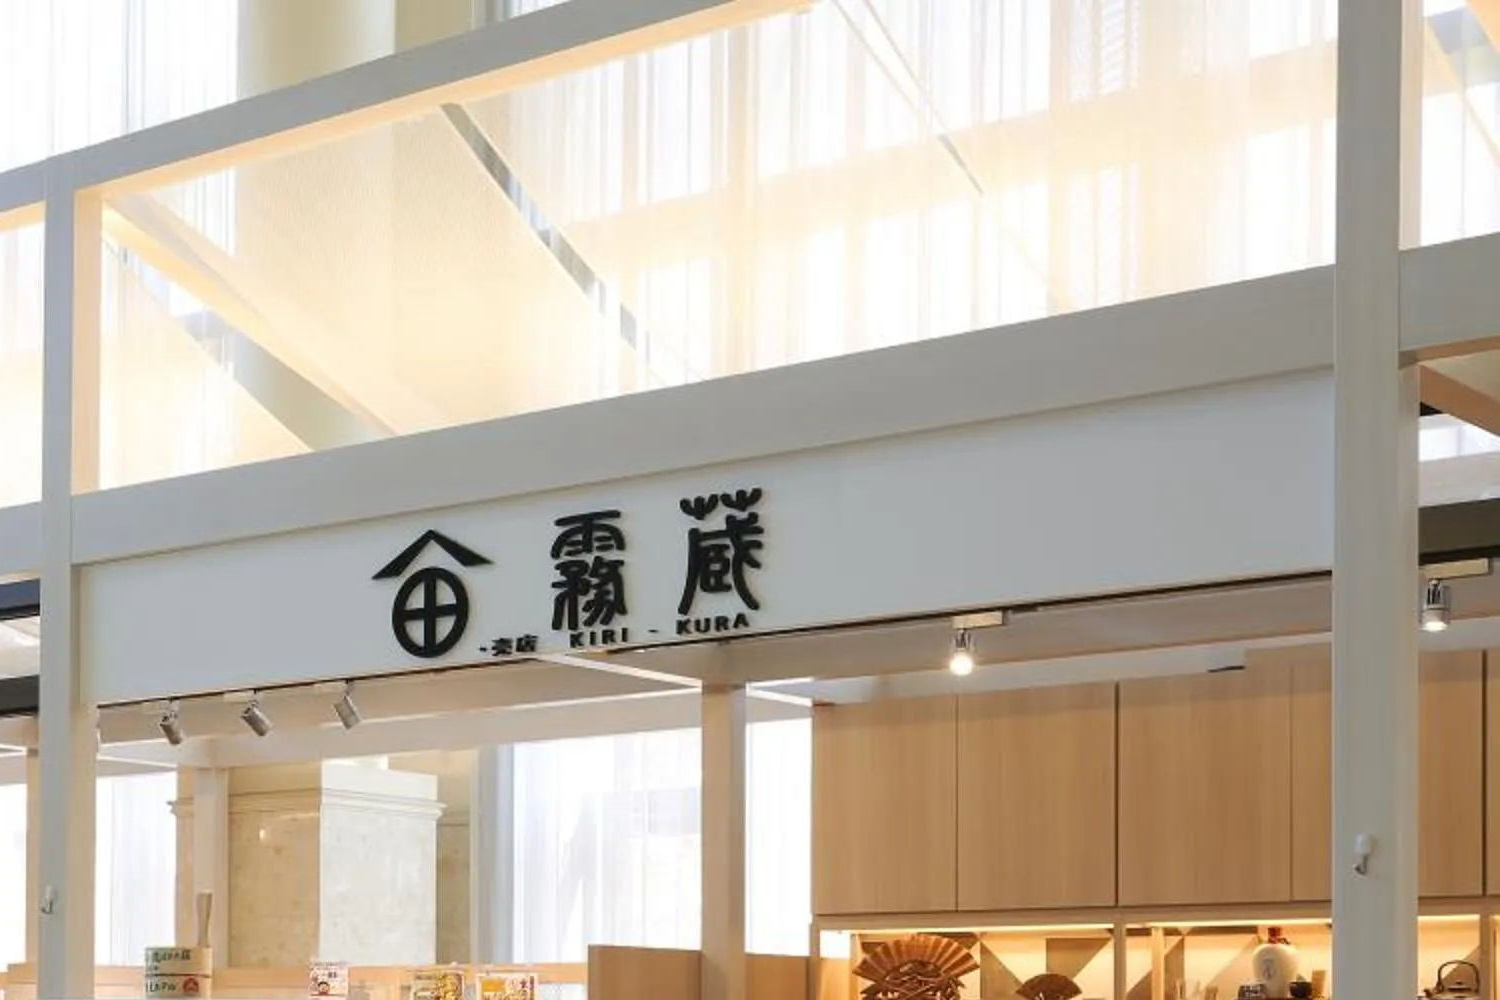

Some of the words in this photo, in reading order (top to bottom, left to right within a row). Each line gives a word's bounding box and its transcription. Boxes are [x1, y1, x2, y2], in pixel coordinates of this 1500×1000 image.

[551, 487, 763, 630] 霧蔵
[570, 627, 629, 648] KIRI
[676, 612, 749, 635] KURA
